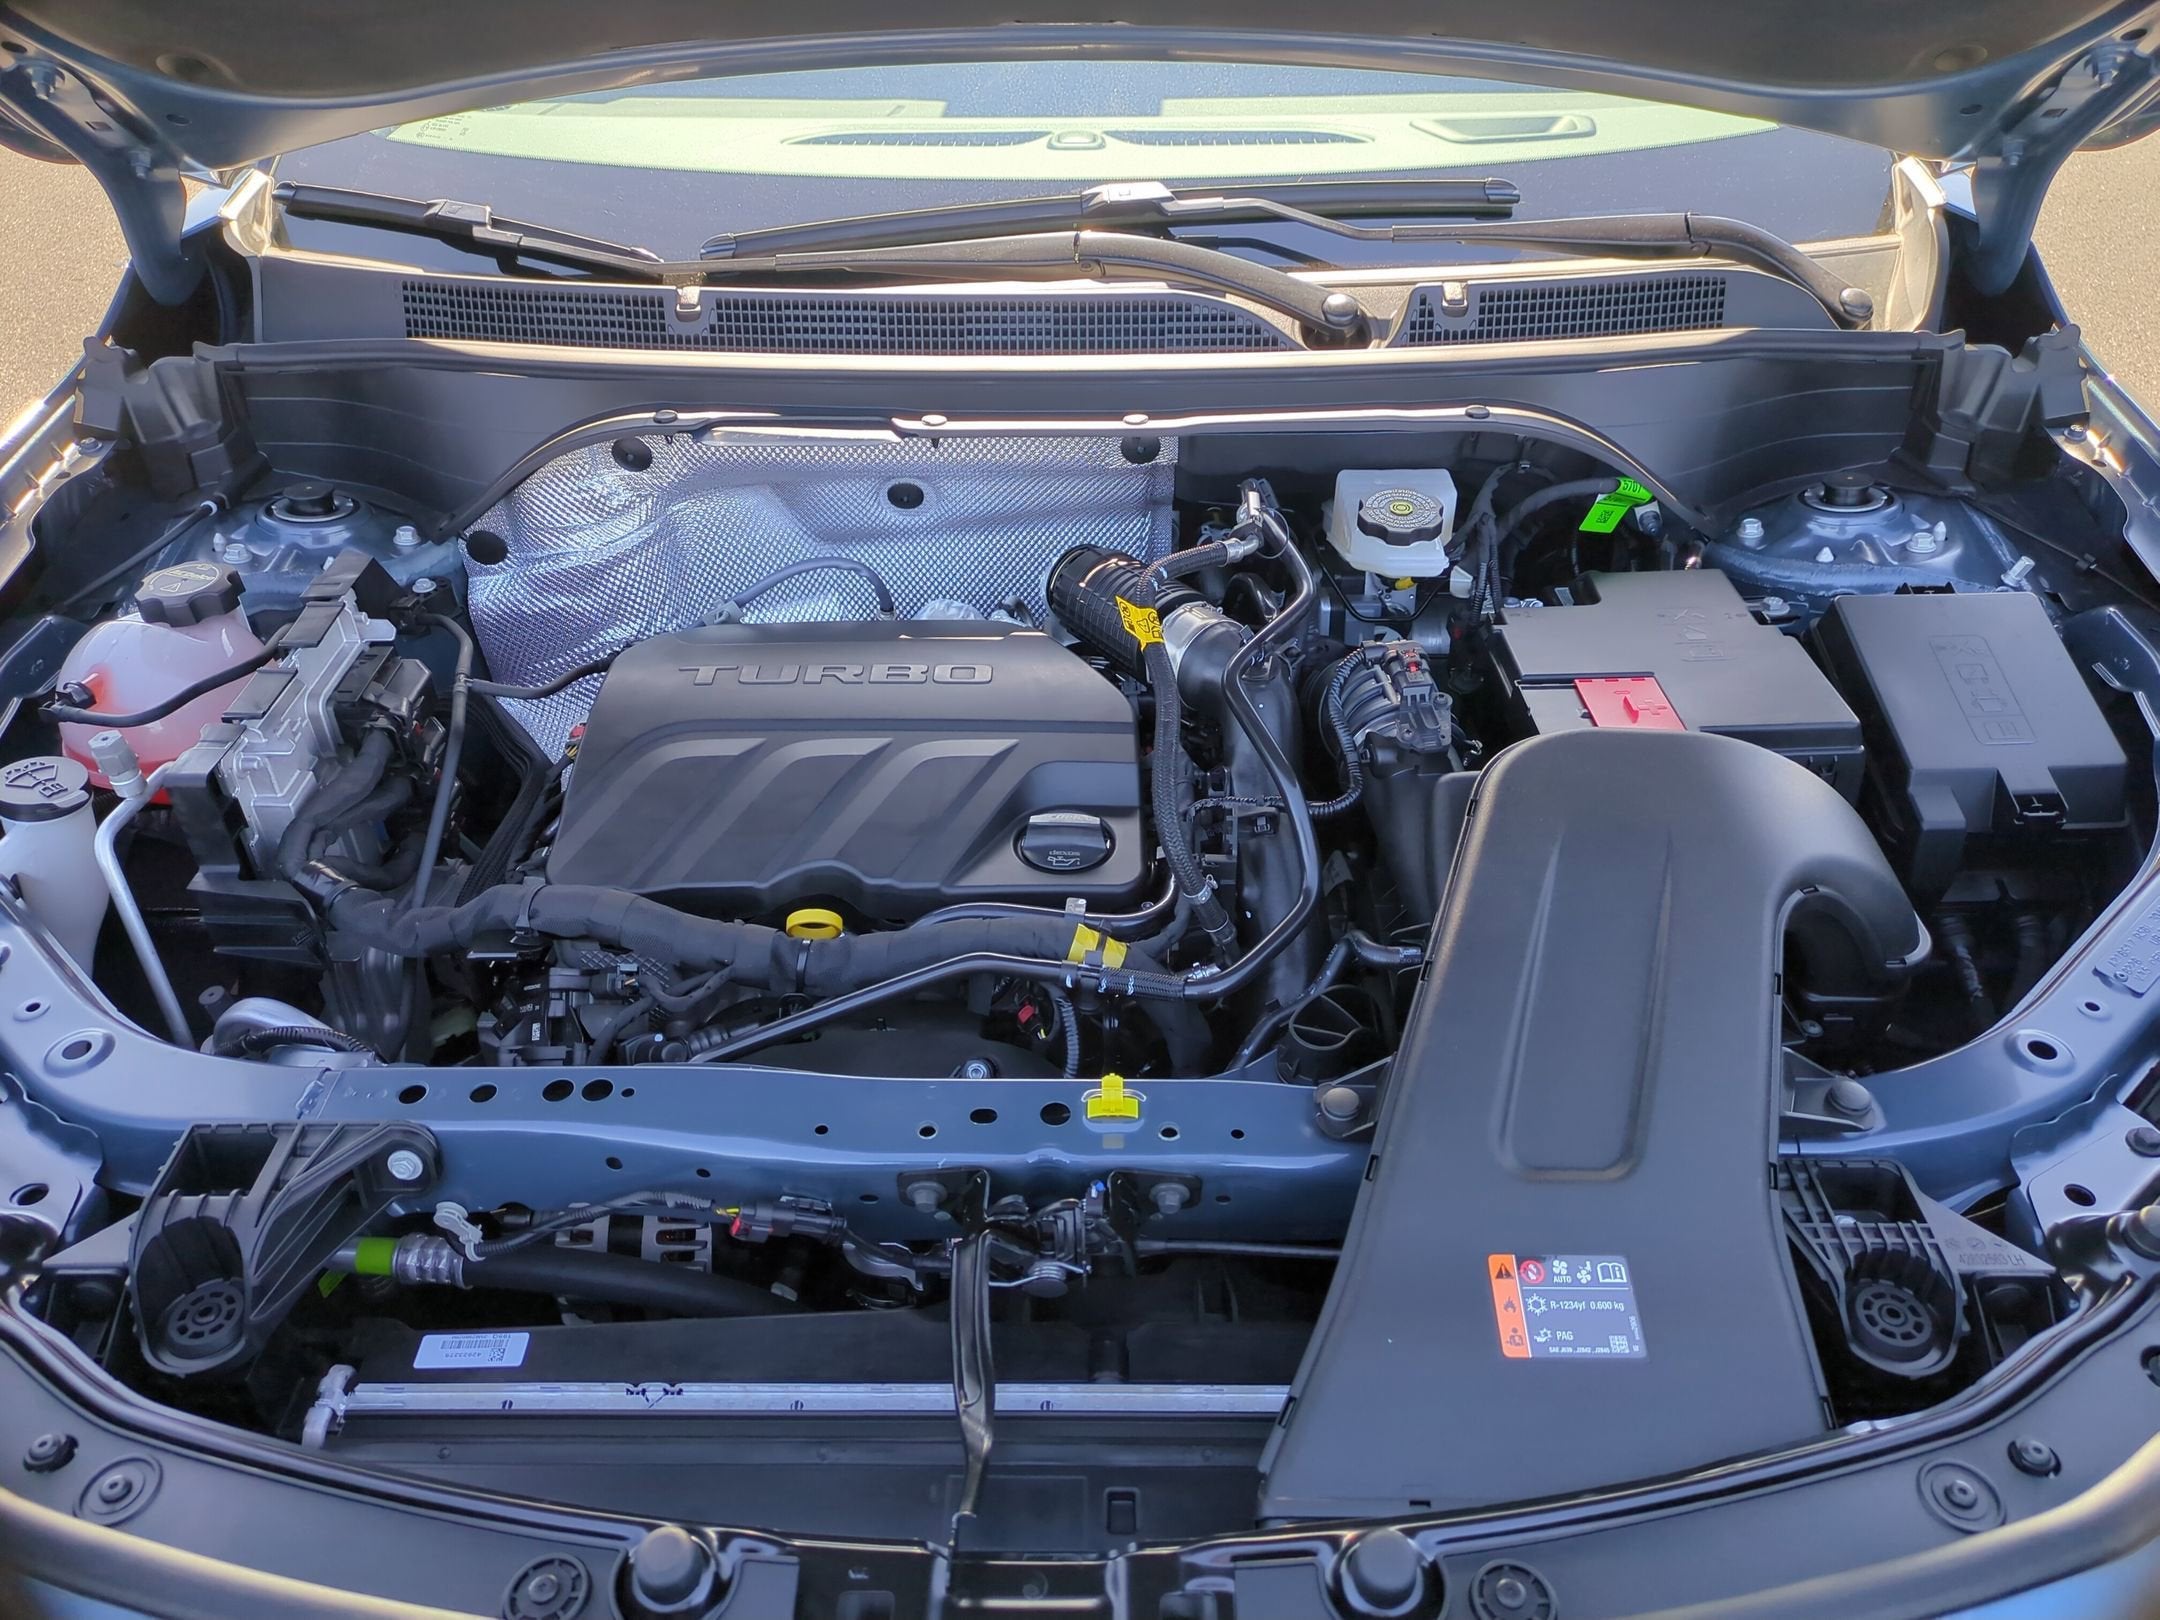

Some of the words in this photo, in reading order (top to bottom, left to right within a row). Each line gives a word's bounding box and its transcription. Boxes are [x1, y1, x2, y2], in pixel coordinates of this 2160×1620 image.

[678, 663, 994, 686] TURBO
[1553, 1275, 1572, 1284] AUTO
[1550, 1300, 1585, 1311] R-1234yf
[1590, 1301, 1612, 1310] 0.600
[1613, 1301, 1625, 1312] kg
[1556, 1330, 1574, 1341] PAG
